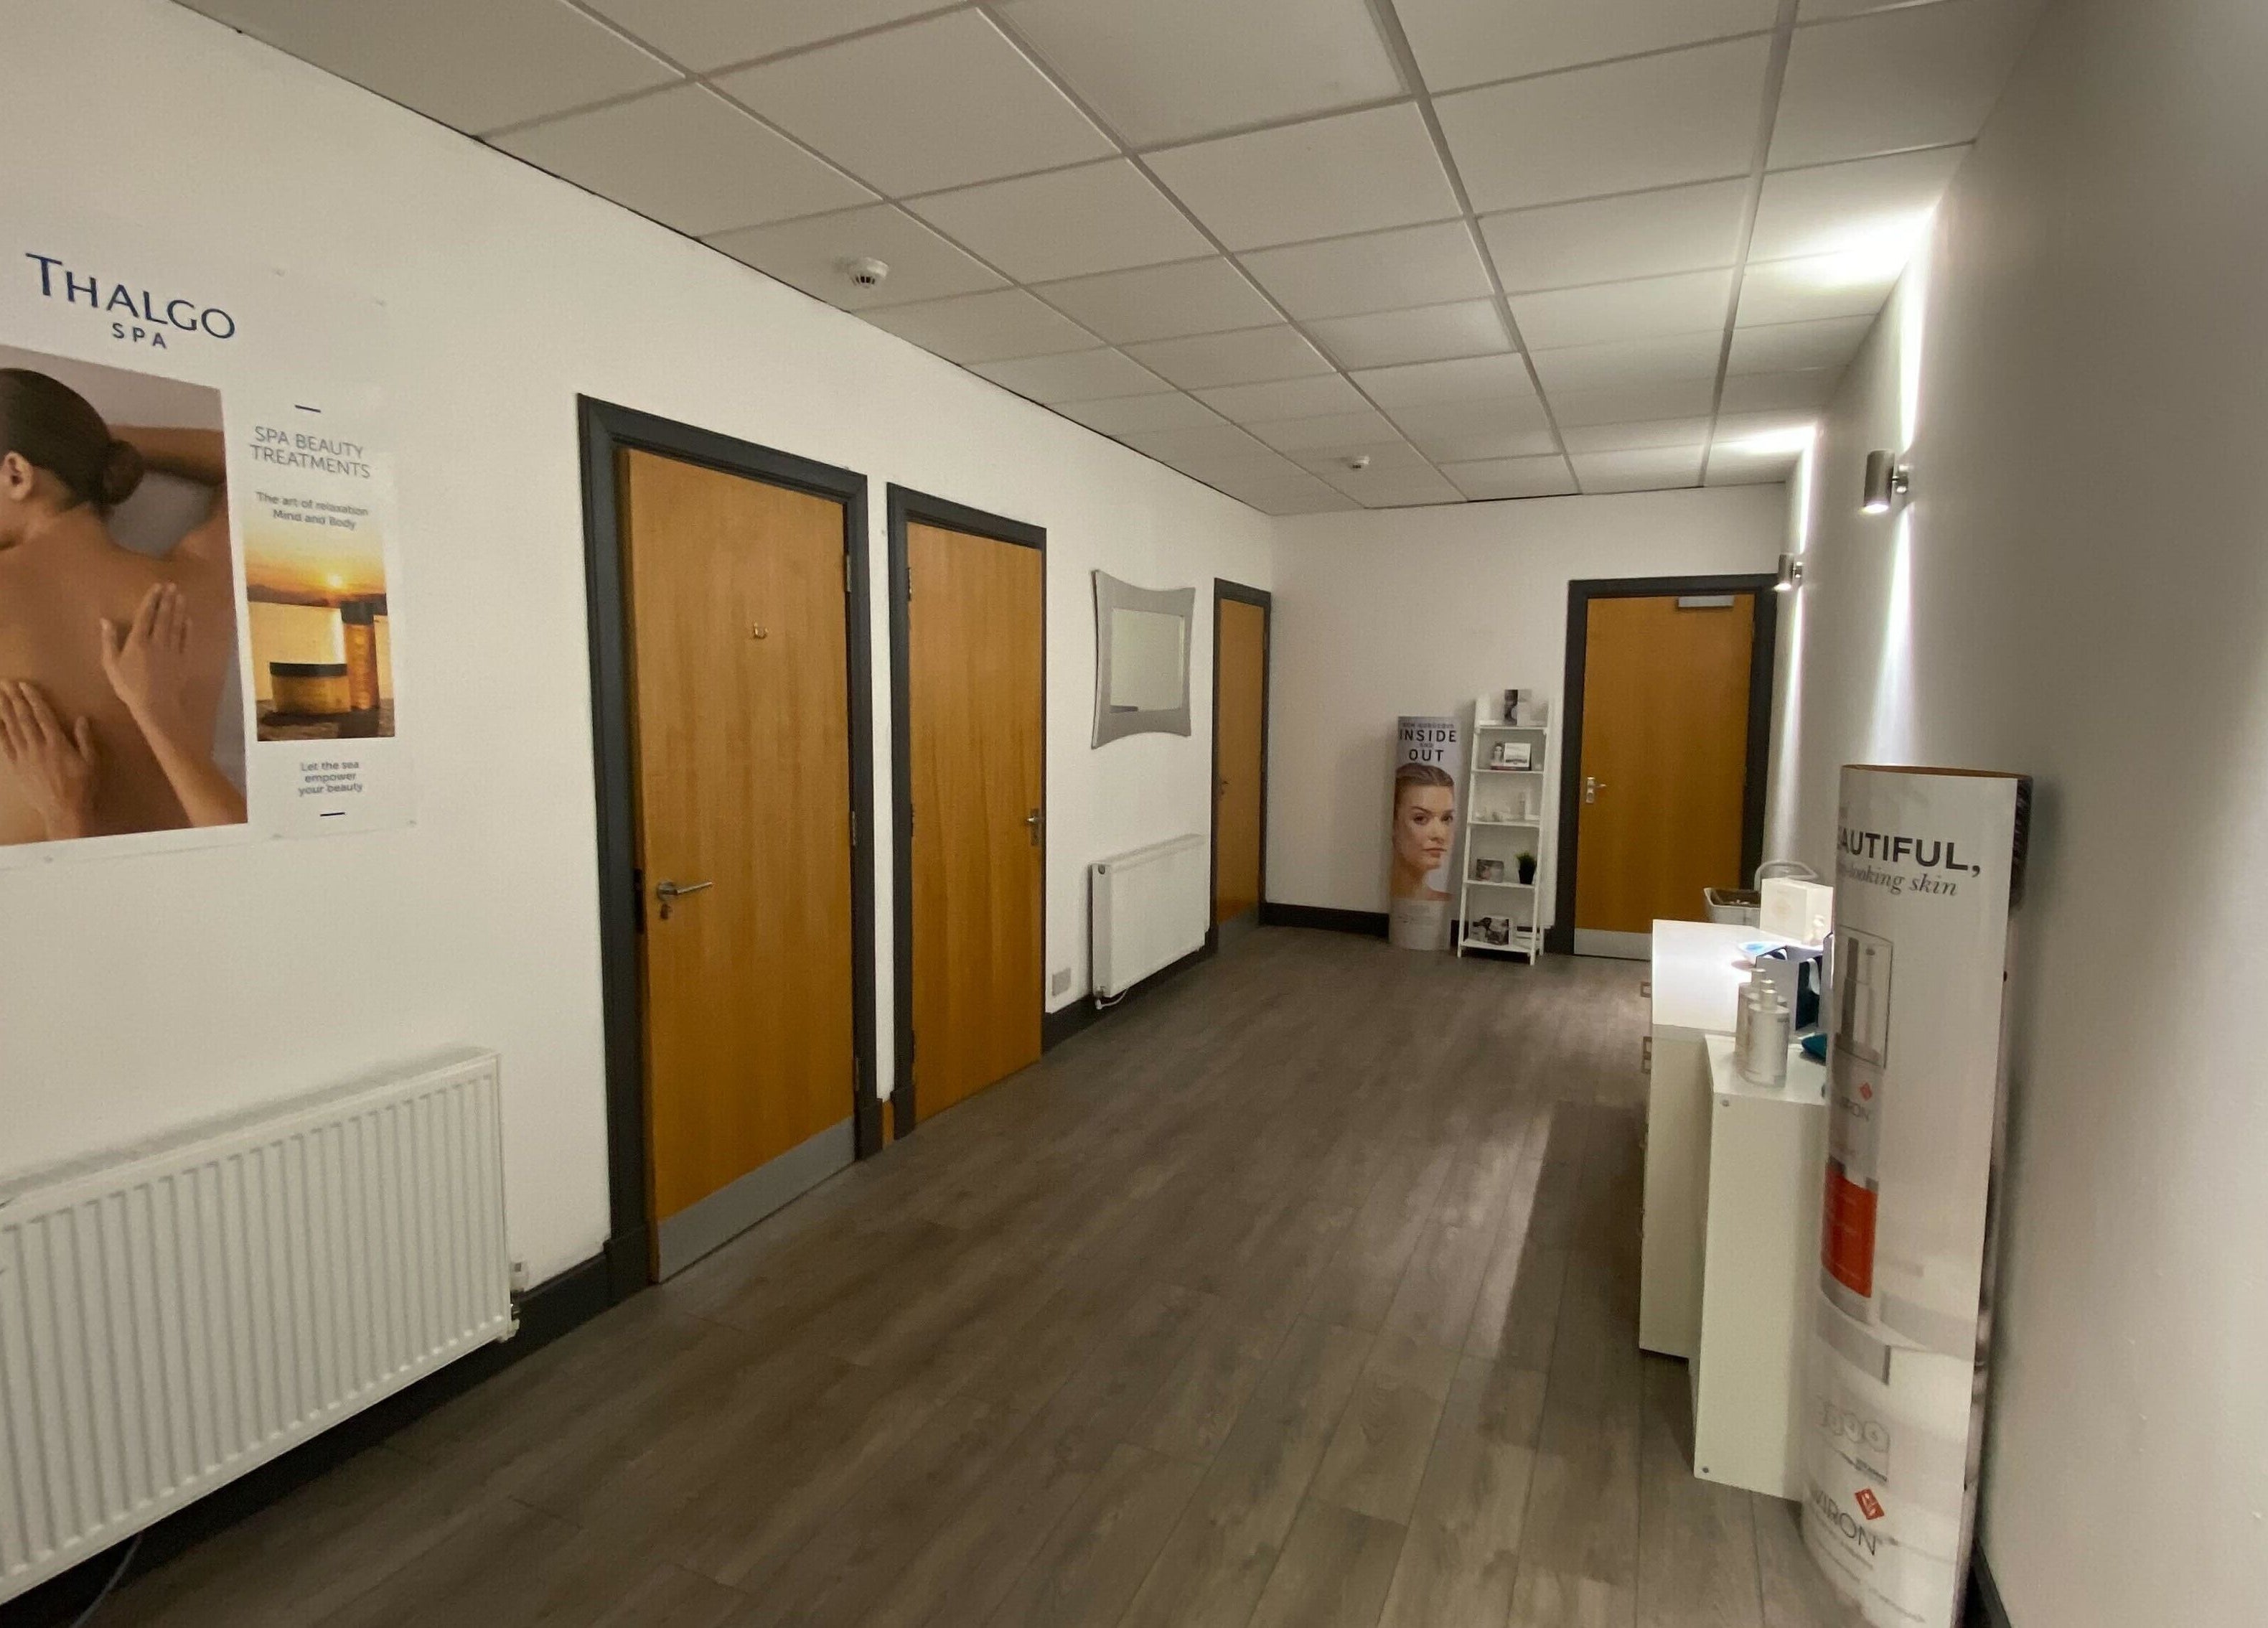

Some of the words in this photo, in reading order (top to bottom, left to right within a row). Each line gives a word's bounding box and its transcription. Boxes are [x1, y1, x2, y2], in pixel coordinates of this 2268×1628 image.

[25, 253, 235, 339] THALGO
[112, 322, 167, 349] SPA
[255, 426, 289, 445] SPA
[295, 434, 363, 459] BEAUTY
[250, 444, 370, 478] TREATMENTS
[256, 490, 279, 504] The
[282, 497, 298, 507] art
[301, 500, 312, 510] of
[316, 502, 368, 516] relaxation
[273, 508, 302, 522] Mind
[305, 515, 325, 525] and
[329, 516, 357, 530] Body
[1400, 729, 1456, 742] INSIDE
[301, 762, 318, 771] Let
[322, 762, 339, 770] the
[1409, 749, 1444, 762] OUT
[299, 786, 324, 797] your
[327, 782, 362, 793] beauty
[304, 773, 356, 784] empower
[1838, 826, 1981, 878] AUTIFUL,
[1908, 872, 1958, 896] skin
[1810, 1487, 1876, 1556] VIRON
